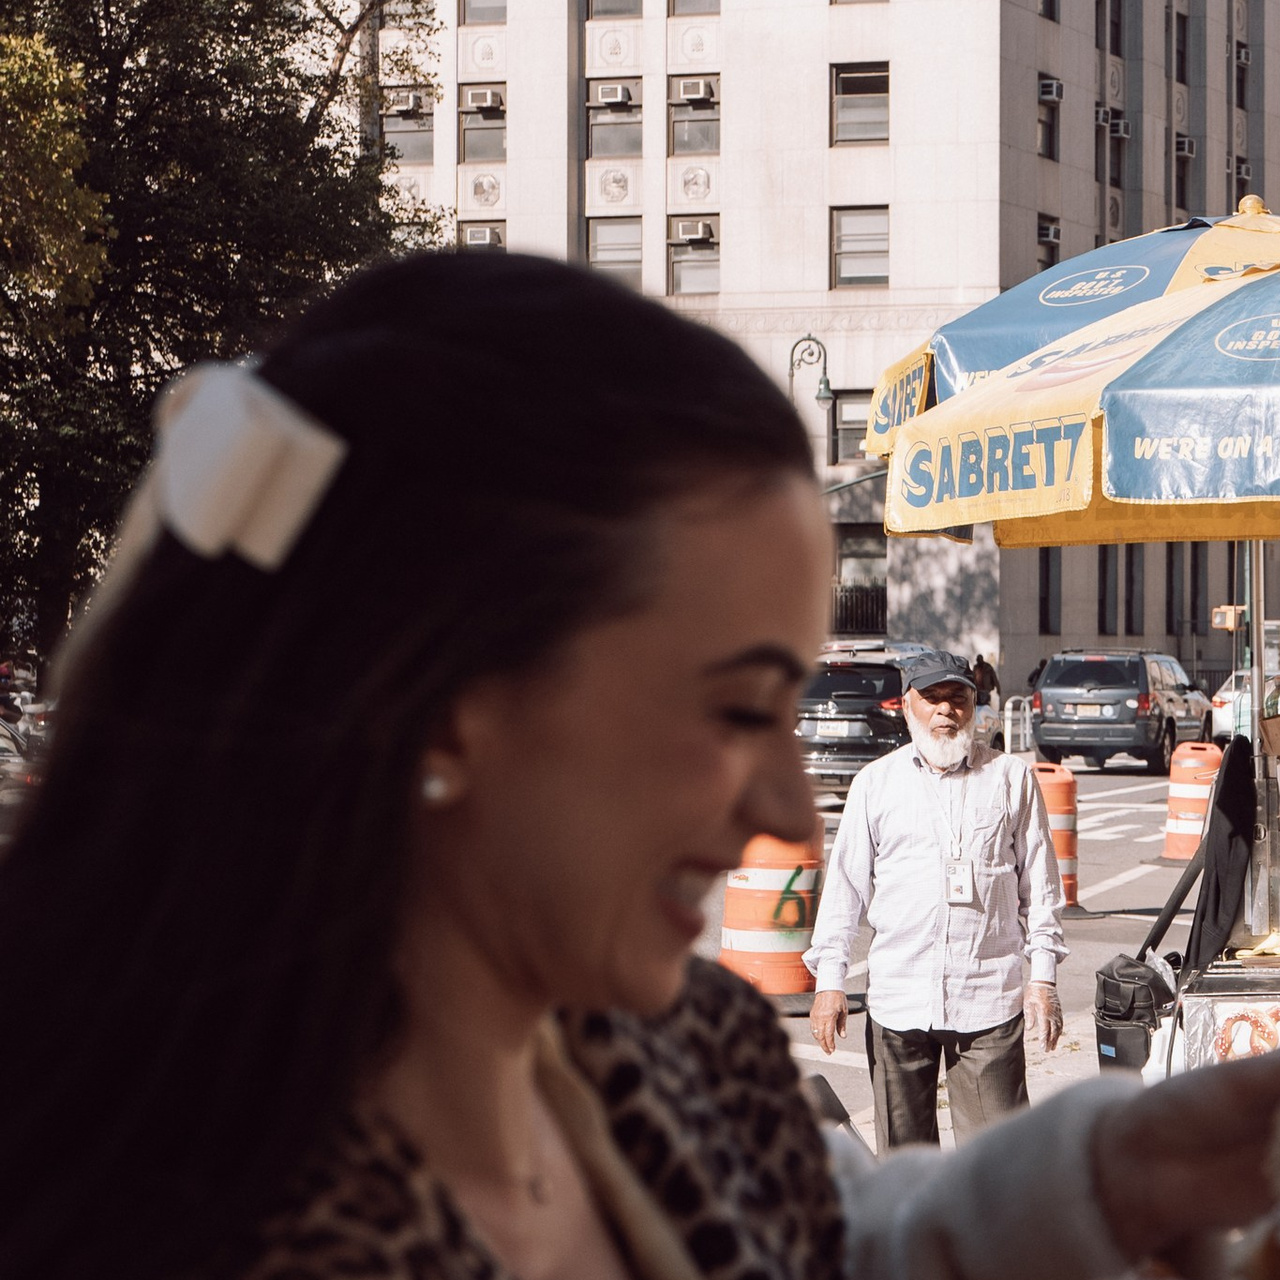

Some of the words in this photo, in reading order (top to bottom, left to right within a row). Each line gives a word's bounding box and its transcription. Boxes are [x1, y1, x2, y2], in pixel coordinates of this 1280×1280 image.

[1045, 285, 1125, 299] INSPECTED
[1134, 436, 1212, 460] WE'RE
[1217, 436, 1252, 459] ON
[1256, 435, 1273, 457] A
[902, 413, 1087, 508] SABRETT
